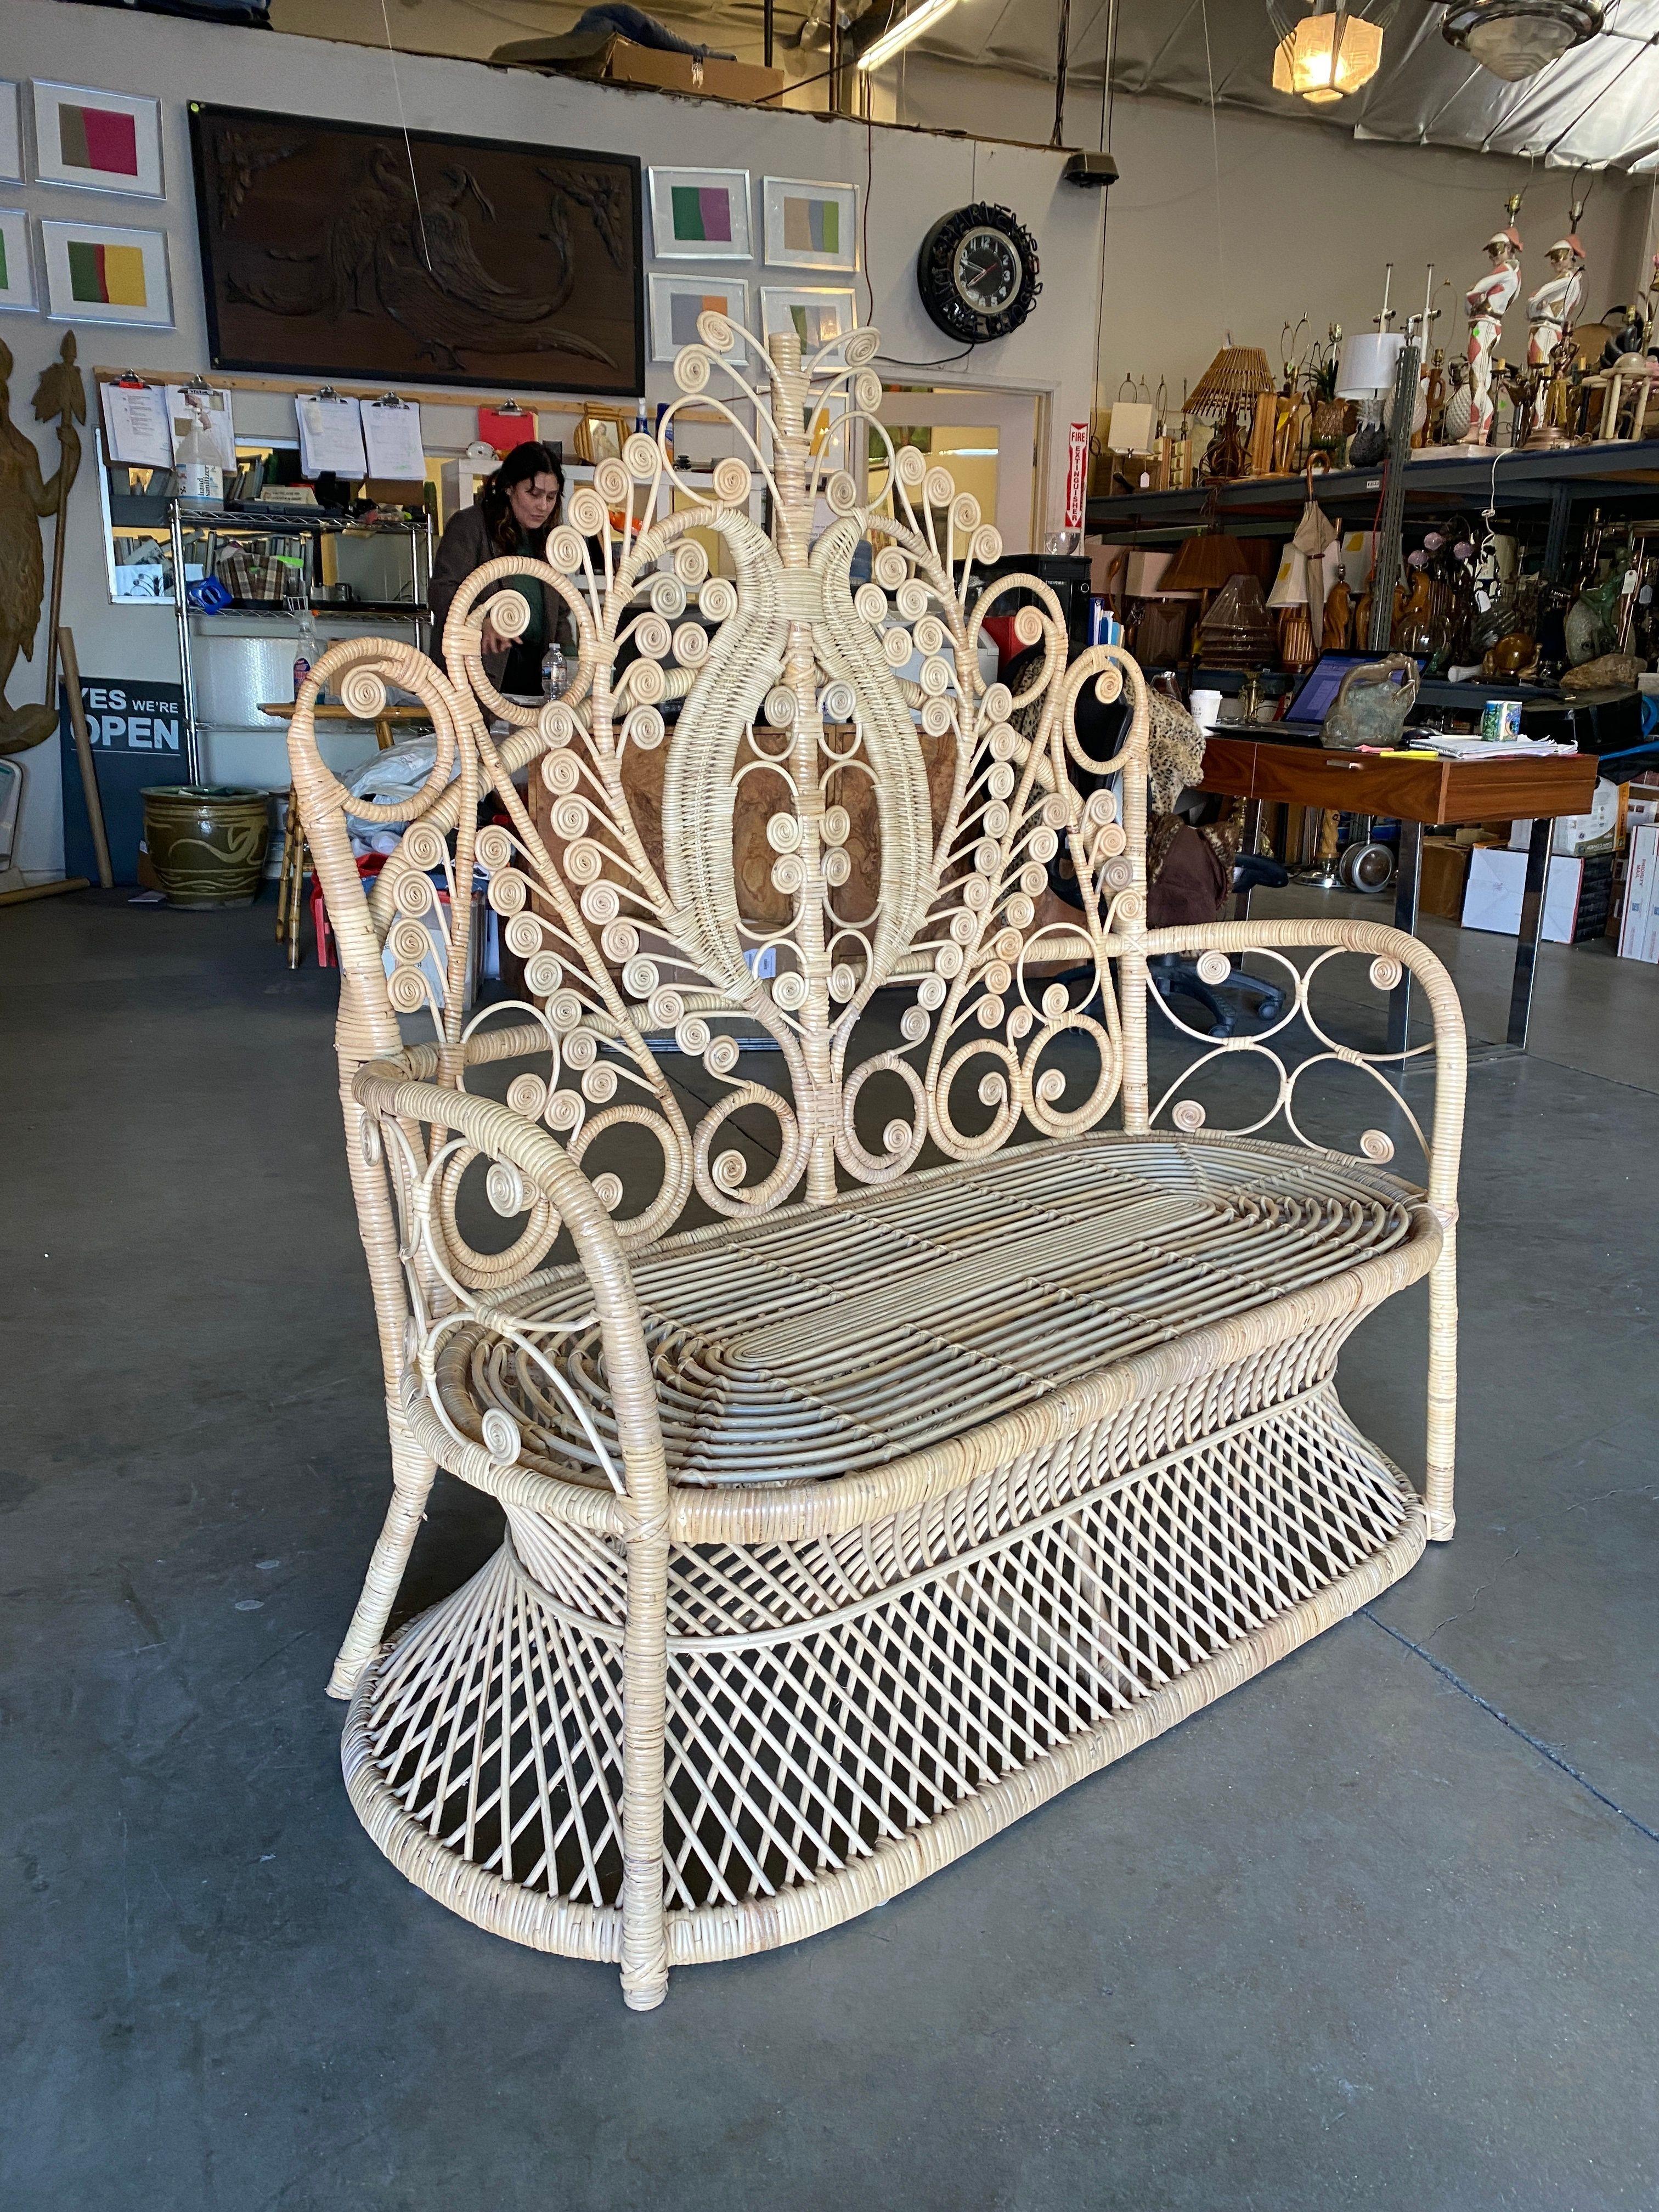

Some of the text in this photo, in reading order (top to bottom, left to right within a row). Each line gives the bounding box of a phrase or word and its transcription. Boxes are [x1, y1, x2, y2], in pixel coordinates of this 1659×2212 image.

[1071, 432, 1086, 442] FIRE
[1072, 445, 1081, 521] EXTINGUISHER
[132, 699, 179, 713] WE'RE
